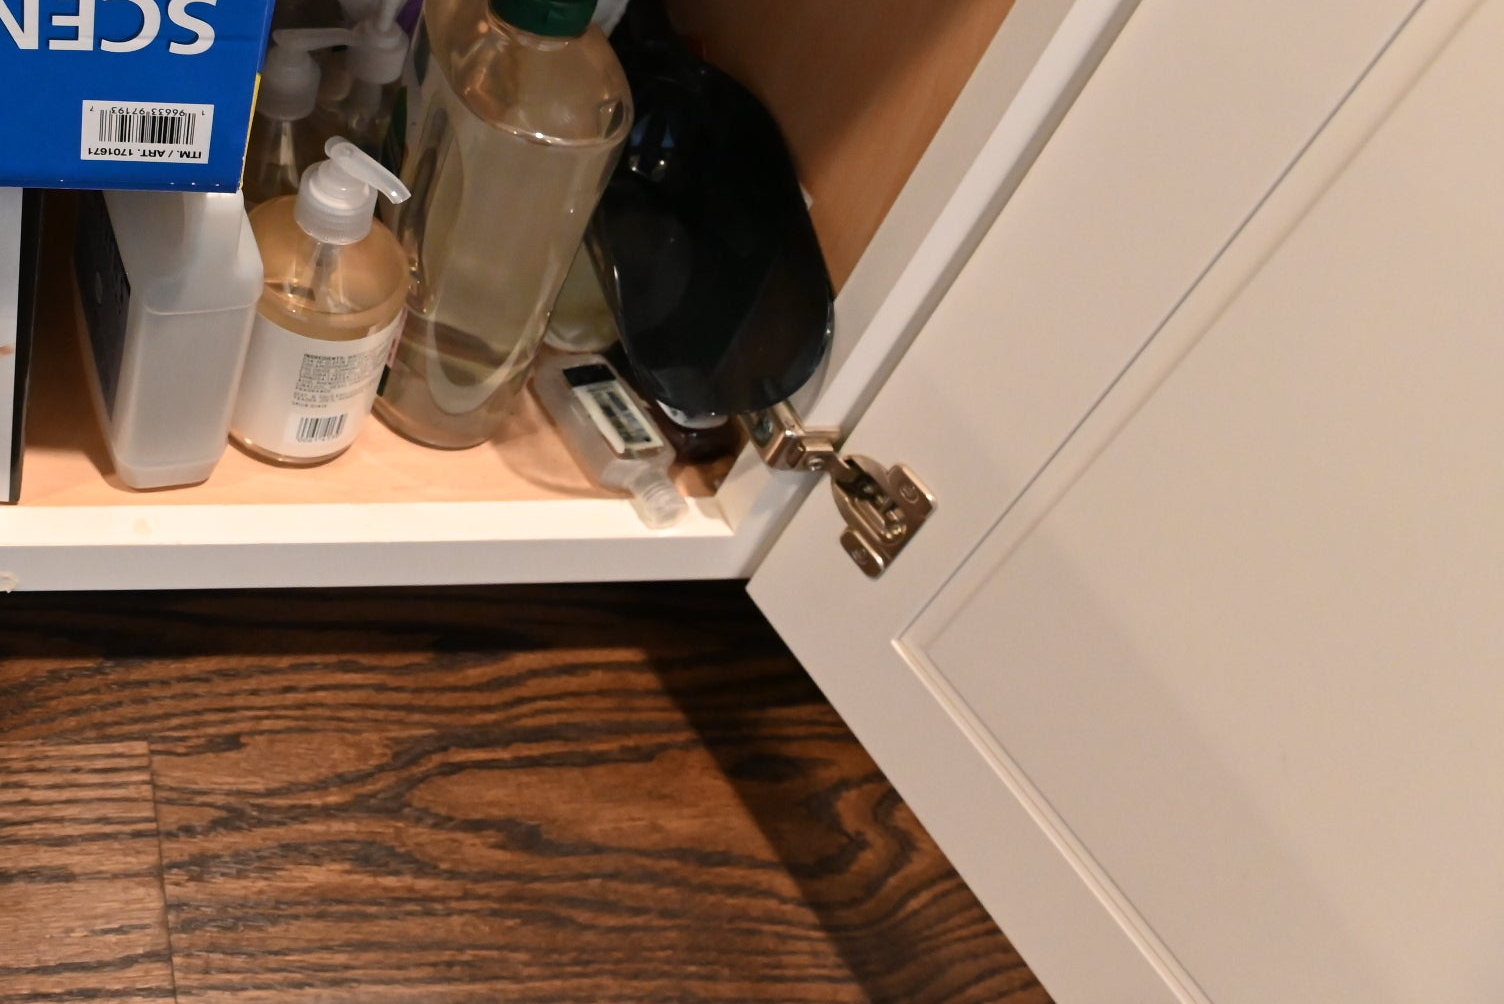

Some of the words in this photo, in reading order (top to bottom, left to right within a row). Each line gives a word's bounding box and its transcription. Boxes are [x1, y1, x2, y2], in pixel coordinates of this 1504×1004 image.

[111, 106, 146, 115] 97193
[151, 108, 186, 116] 96633
[88, 147, 134, 156] 1701671
[137, 149, 166, 158] ART.
[177, 150, 202, 159] ITM.
